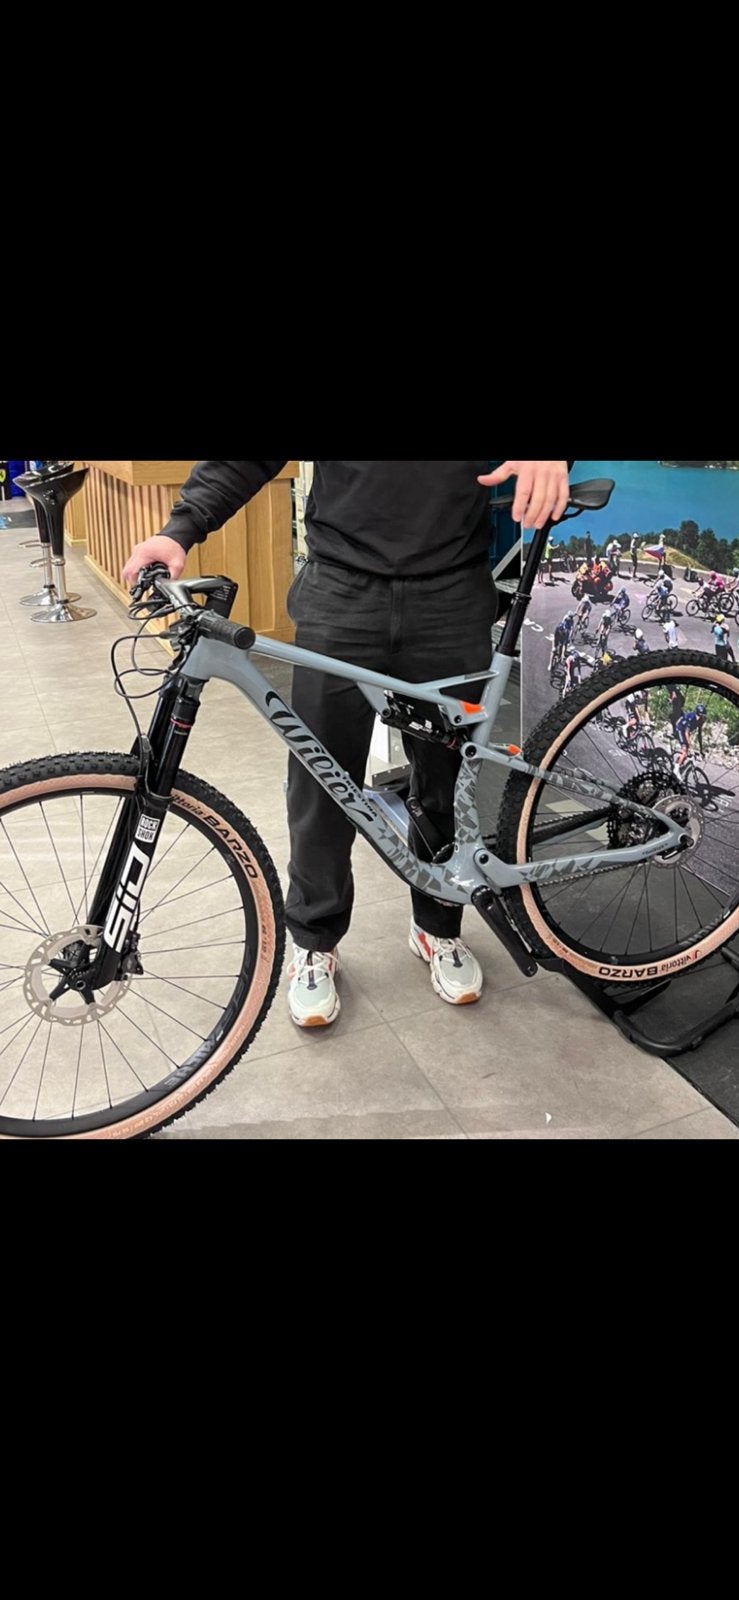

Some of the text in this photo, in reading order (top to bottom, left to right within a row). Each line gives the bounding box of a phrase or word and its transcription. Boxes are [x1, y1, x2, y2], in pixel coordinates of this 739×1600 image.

[265, 690, 374, 822] Wilier
[140, 816, 159, 831] ROCK
[203, 814, 258, 878] BARZO
[103, 841, 151, 953] SID
[598, 954, 692, 979] vittoria BARZO
